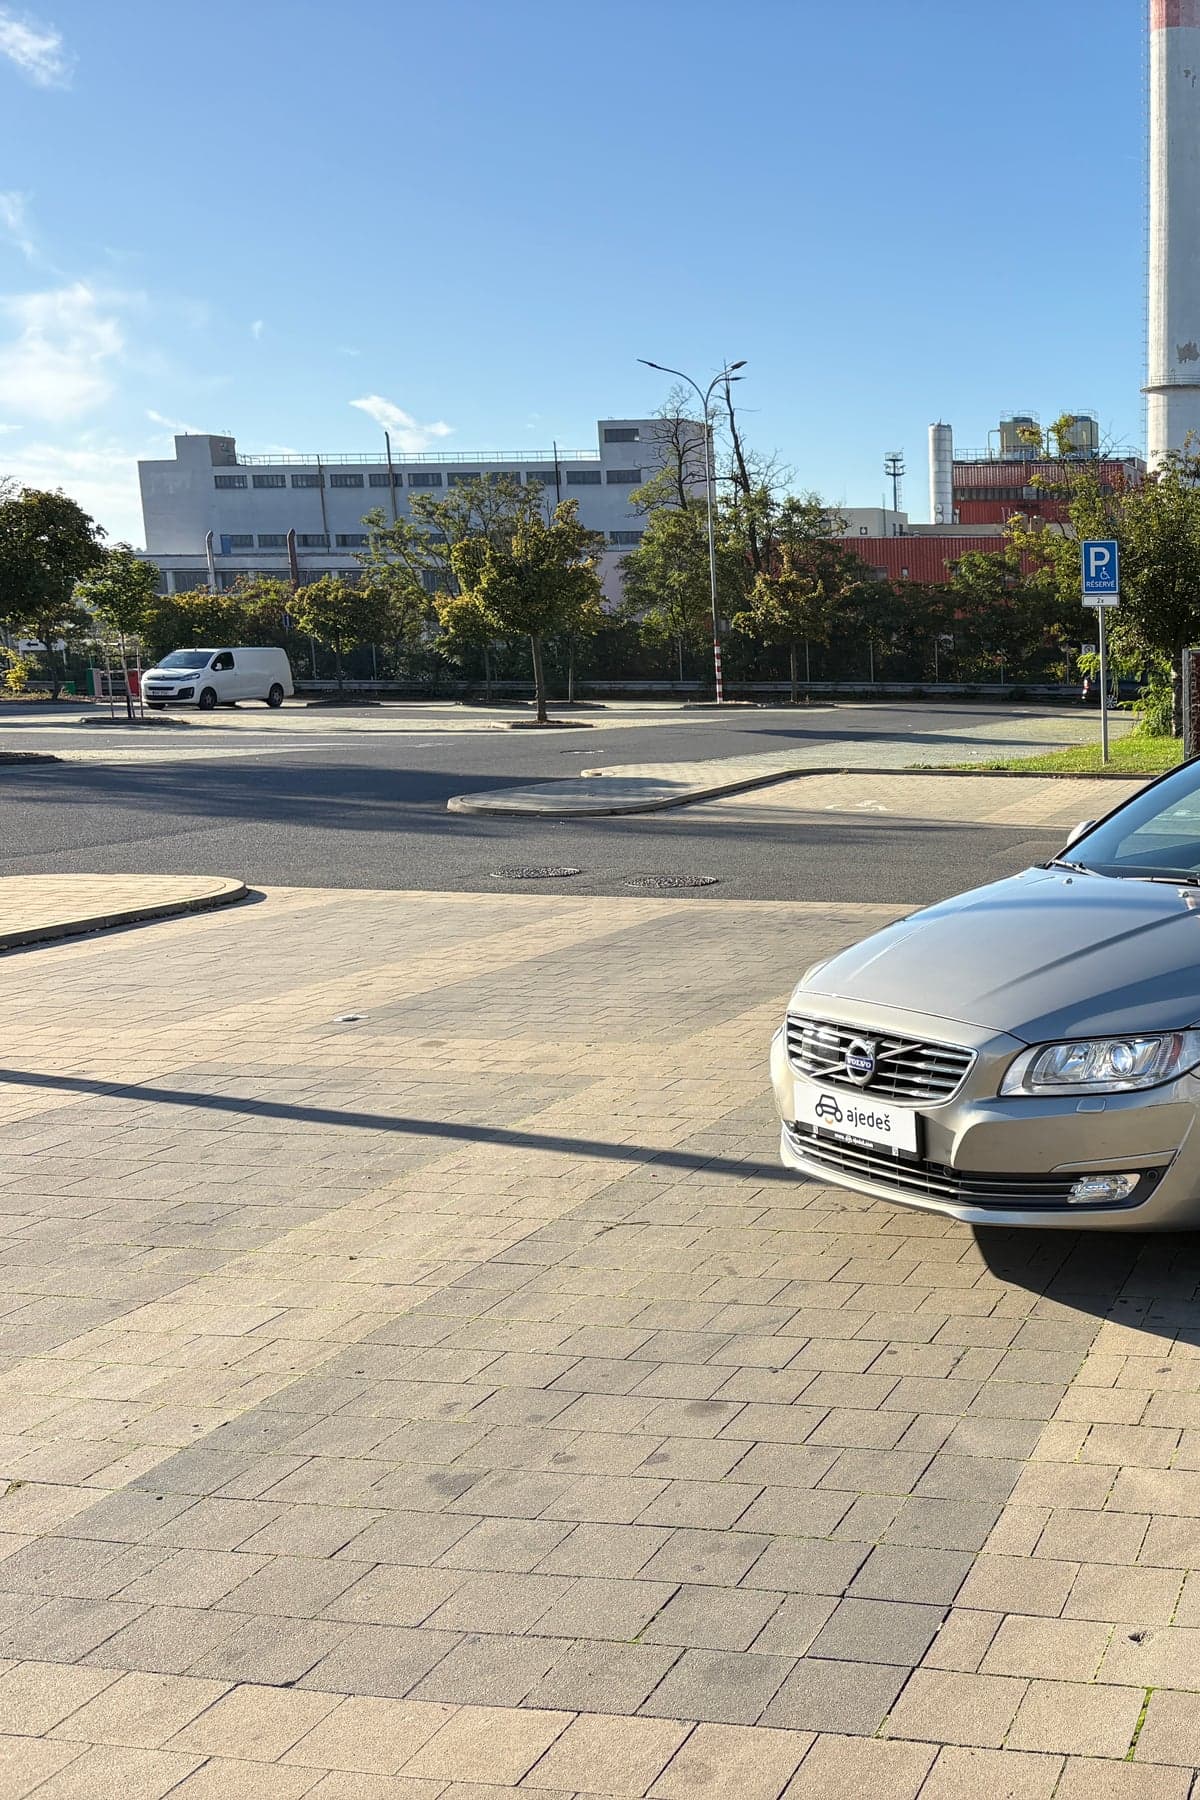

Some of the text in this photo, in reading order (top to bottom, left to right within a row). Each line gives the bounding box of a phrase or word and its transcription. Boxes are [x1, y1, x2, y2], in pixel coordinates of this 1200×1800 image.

[1090, 547, 1110, 577] P
[847, 1057, 872, 1069] VOLVO
[846, 1107, 891, 1132] ajedeš
